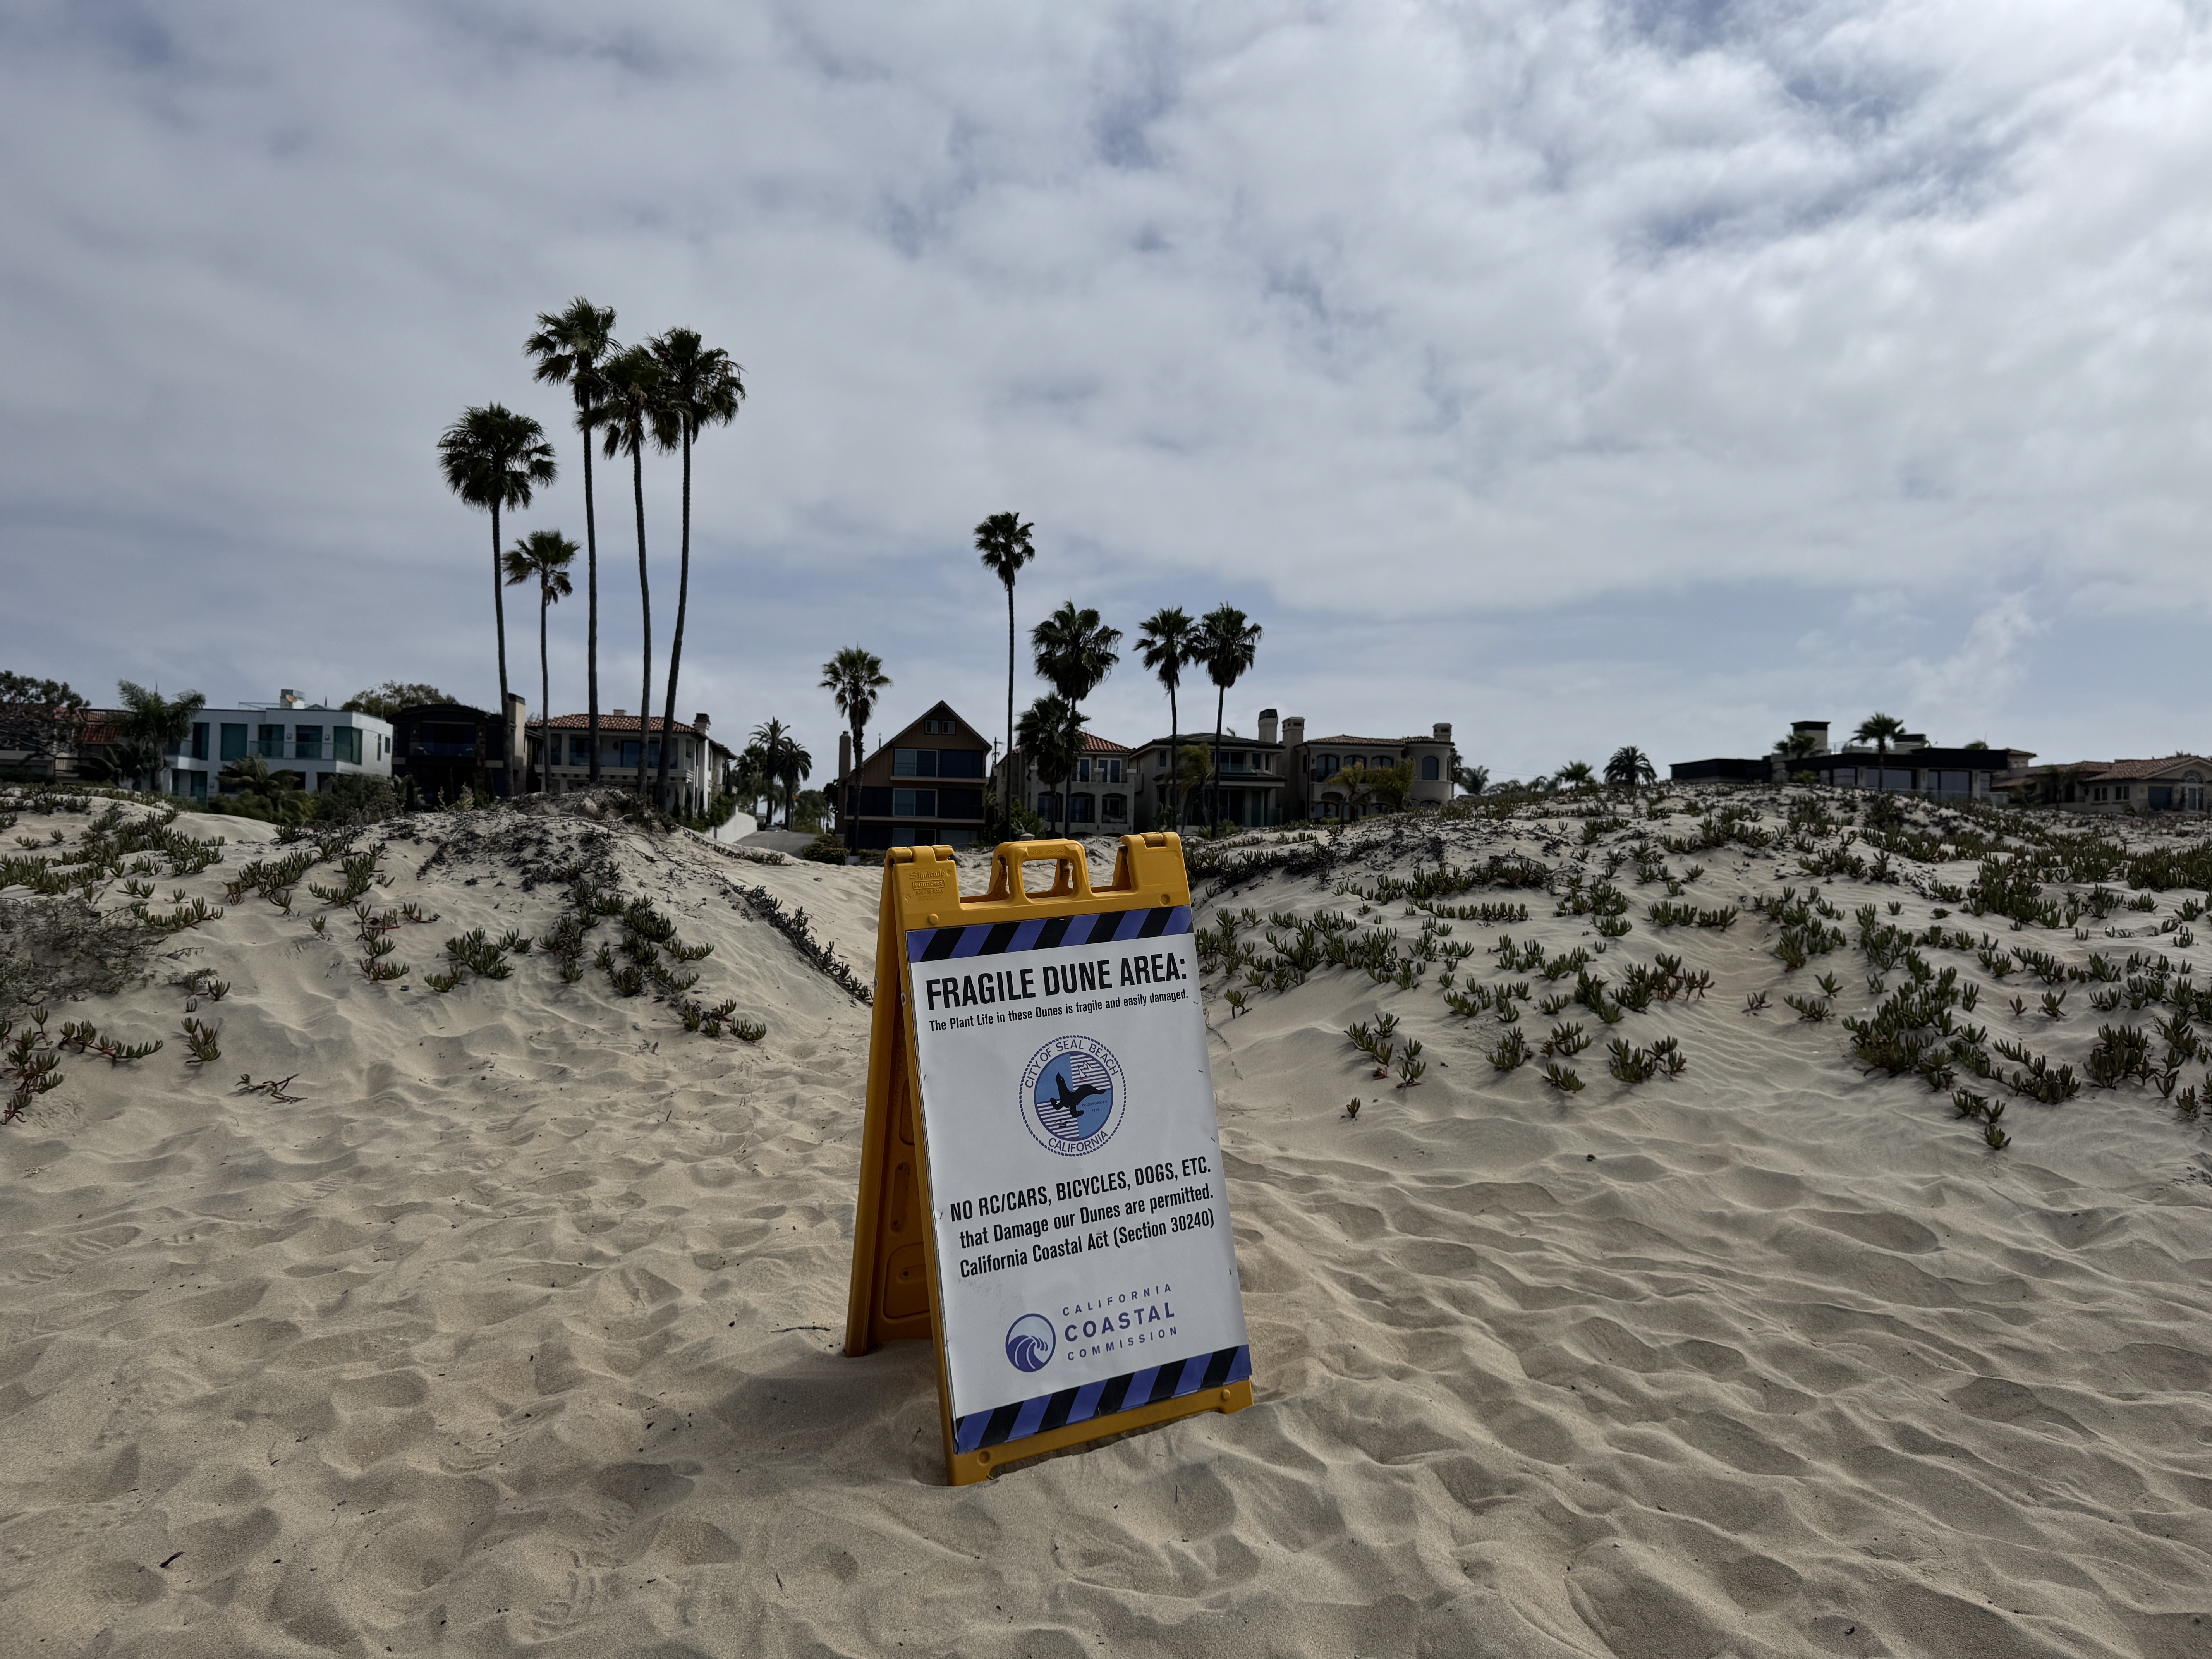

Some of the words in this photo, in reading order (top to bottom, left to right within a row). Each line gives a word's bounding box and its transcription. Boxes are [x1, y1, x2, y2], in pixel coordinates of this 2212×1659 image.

[926, 968, 1036, 1010] FRAGILE
[1043, 960, 1112, 996] DUNE
[1120, 953, 1187, 987] AREA:
[929, 1020, 946, 1031] The
[950, 1016, 974, 1029] Plant
[977, 1013, 993, 1025] Life
[997, 1012, 1005, 1023] in
[1008, 1010, 1032, 1021] these
[1036, 1007, 1062, 1017] Dunes
[1066, 1003, 1073, 1014] is
[1076, 1000, 1102, 1013] fragile
[1106, 997, 1120, 1008] and
[1124, 994, 1146, 1006] easily
[1150, 989, 1188, 1003] damaged.
[1025, 1060, 1041, 1088] CITY
[1040, 1047, 1051, 1061] OF
[1056, 1039, 1084, 1051] SEAL
[1089, 1043, 1118, 1075] BEACH
[1048, 1130, 1109, 1152] CALIFORNIA
[950, 1200, 972, 1222] NO
[979, 1186, 1051, 1216] RC/CARS,
[1056, 1171, 1130, 1201] BICYCLES,
[1135, 1163, 1178, 1186] DOGS,
[1182, 1156, 1211, 1176] ETC.
[959, 1227, 989, 1249] that
[993, 1219, 1048, 1242] Damage
[1054, 1214, 1075, 1229] our
[1080, 1205, 1120, 1224] Dunes
[1125, 1200, 1145, 1215] are
[1150, 1183, 1213, 1214] permitted.
[960, 1249, 1027, 1278] California
[1033, 1236, 1082, 1262] Coastal
[1088, 1230, 1109, 1250] Act
[1113, 1221, 1166, 1248] (Section
[1171, 1208, 1214, 1232] 30240)
[1063, 1284, 1171, 1316] CALIFORNIA
[1065, 1302, 1174, 1341] COASTAL
[1068, 1326, 1176, 1360] COMMISSION
